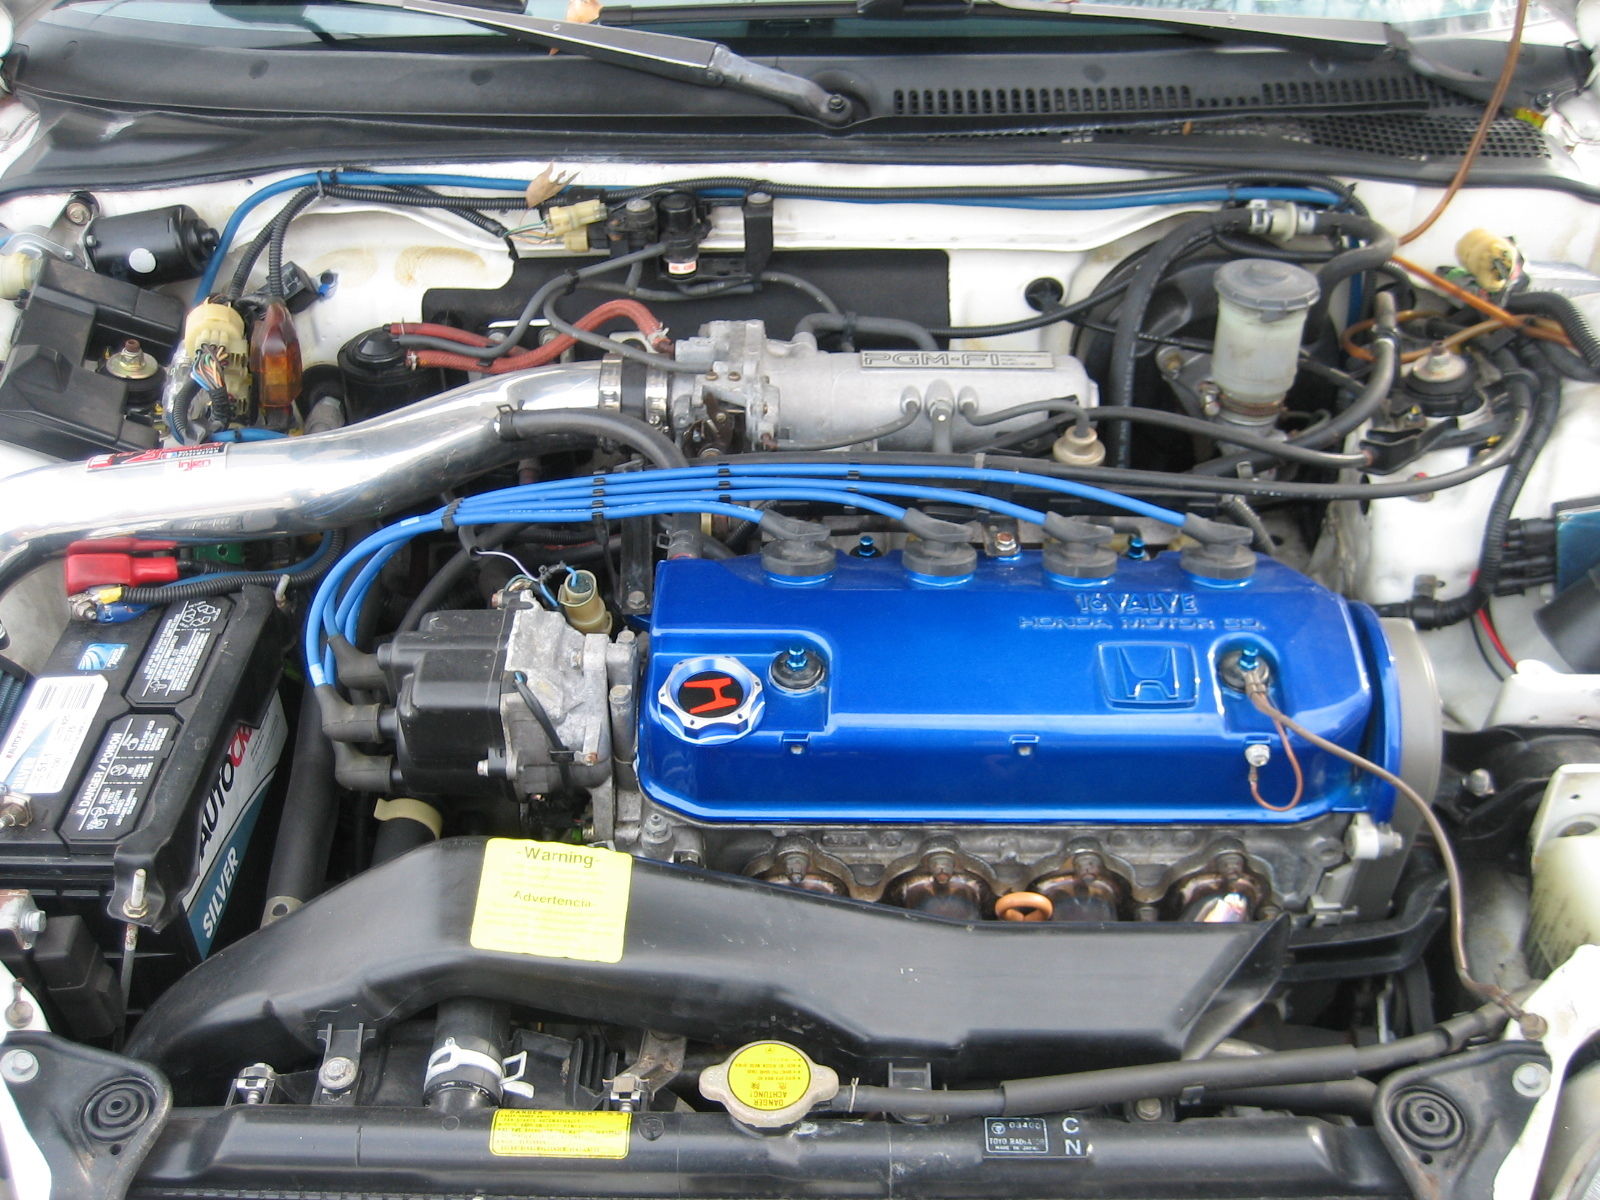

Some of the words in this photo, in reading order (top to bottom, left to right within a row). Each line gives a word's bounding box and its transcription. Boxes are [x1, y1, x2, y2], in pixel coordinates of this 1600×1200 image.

[1018, 615, 1113, 630] HONDA
[1121, 616, 1216, 631] MOTOR
[78, 771, 104, 807] DANGER
[99, 732, 123, 763] POISON
[525, 846, 594, 868] Warning
[202, 846, 239, 939] SILVER
[1062, 1117, 1079, 1133] C
[1064, 1139, 1082, 1155] N
